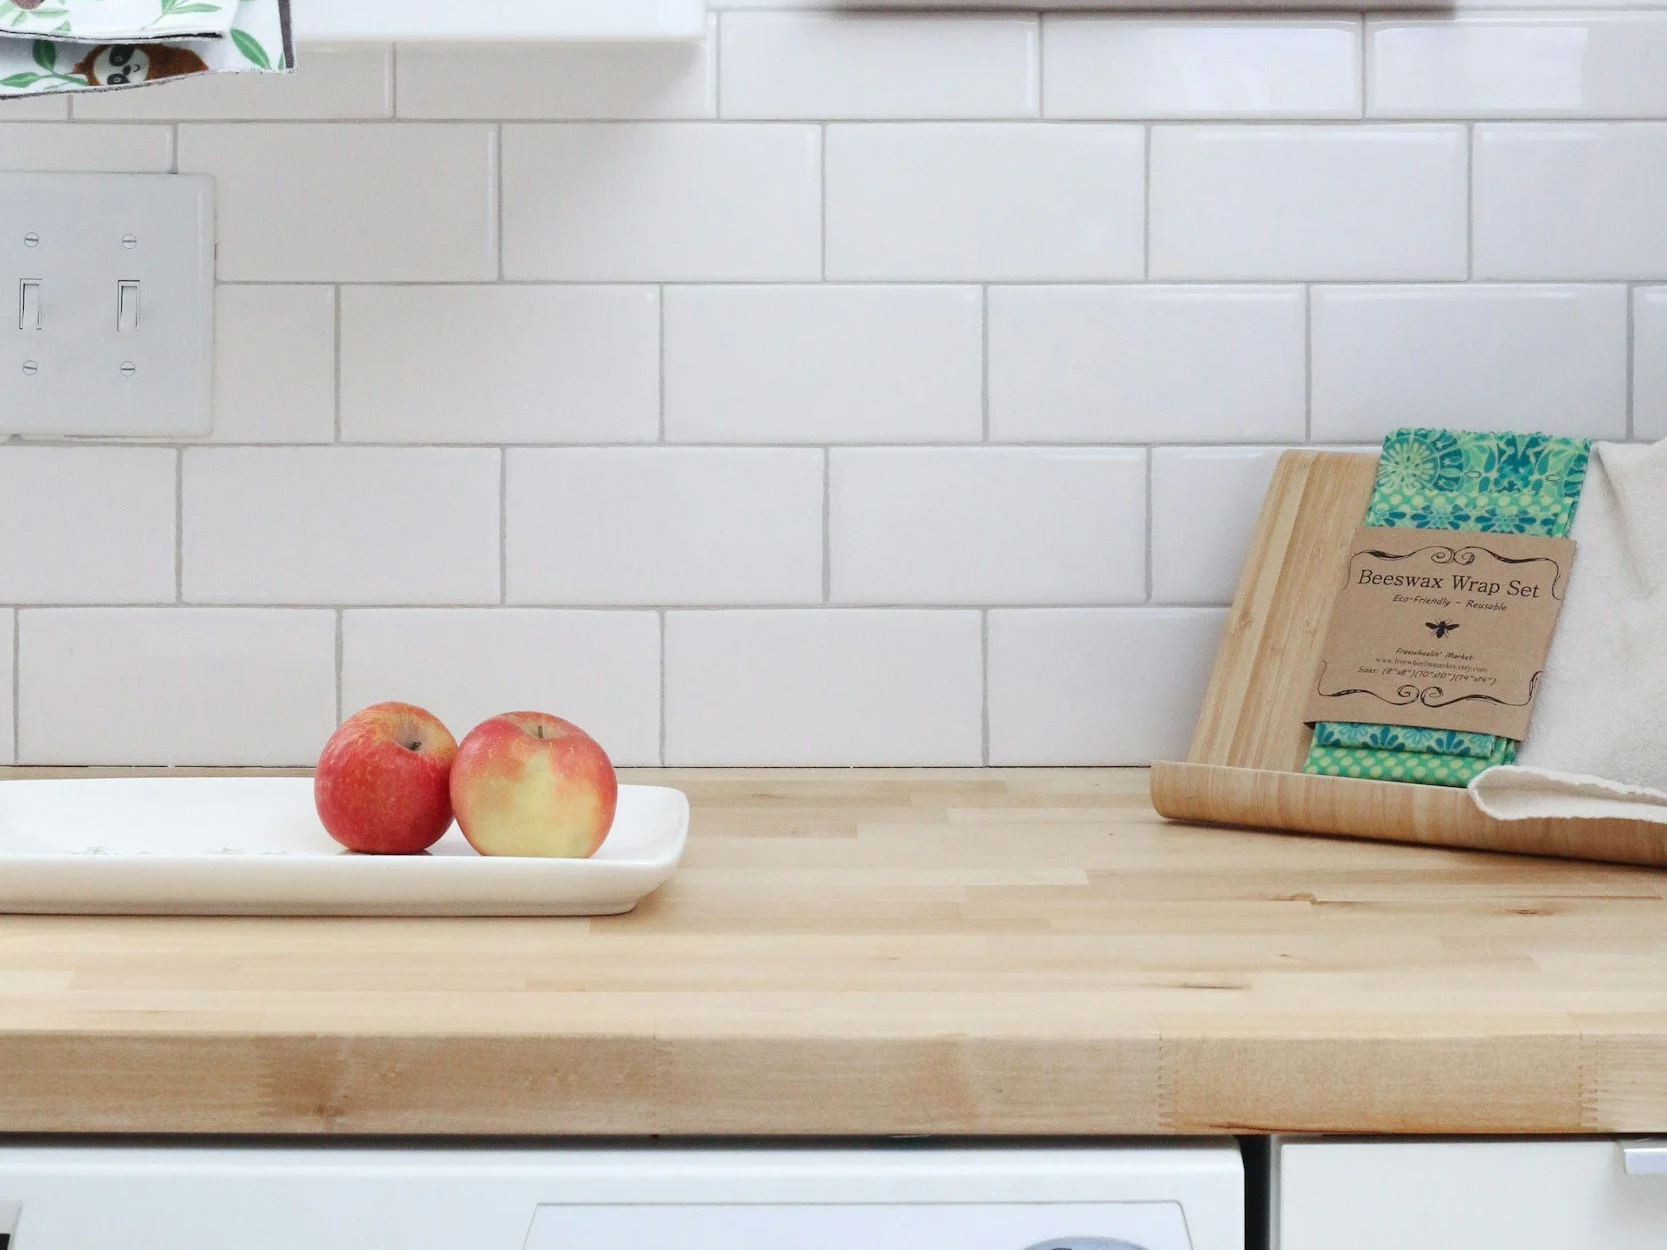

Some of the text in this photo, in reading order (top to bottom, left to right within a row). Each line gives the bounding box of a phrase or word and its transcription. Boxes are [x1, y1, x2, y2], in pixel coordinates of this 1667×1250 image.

[1358, 569, 1540, 598] Beeswax Wrap Set
[1393, 595, 1451, 607] Eco-Friendly
[1466, 600, 1507, 612] Reusable
[1446, 652, 1473, 661] Market
[1358, 666, 1379, 674] Sizes:
